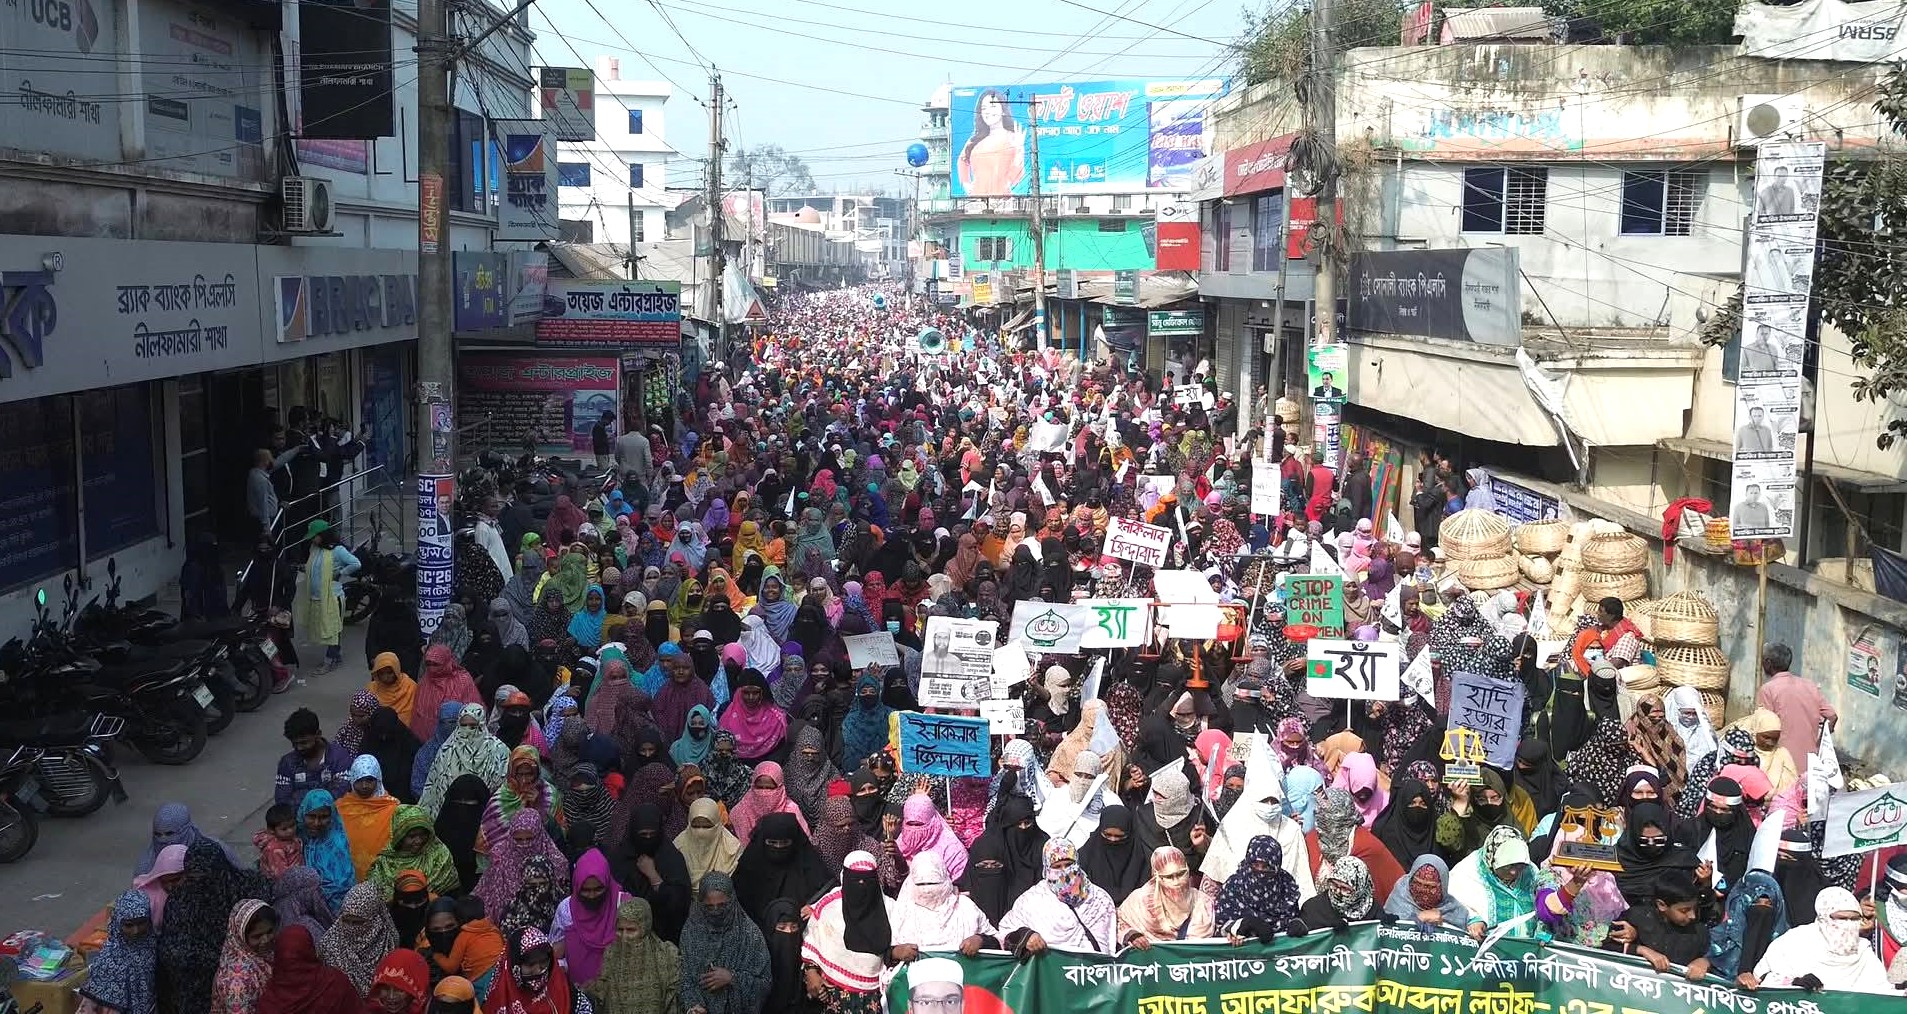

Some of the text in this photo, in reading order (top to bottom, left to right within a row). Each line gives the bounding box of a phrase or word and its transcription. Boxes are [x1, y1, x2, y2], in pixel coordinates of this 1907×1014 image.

[31, 0, 72, 31] UCB
[1840, 25, 1898, 40] BSRM
[18, 79, 101, 124] নীলফামারী শাখা
[116, 273, 236, 314] ব্র্যাক ব্যাংক পিএলসি
[1373, 271, 1446, 298] সোনালী ব্যাংক পিএলসি
[134, 318, 228, 359] নীলফামারী শাখা
[1291, 580, 1334, 596] STOP
[1289, 598, 1333, 611] CRIME
[1302, 611, 1323, 623] ON
[1324, 639, 1388, 692] হ্যাঁ
[1459, 682, 1515, 713] হাদি
[1062, 961, 1161, 985] বাংলাদেশ
[1167, 959, 1266, 984] জামায়াতে
[1523, 952, 1603, 989] নির্বাচনী
[1609, 967, 1666, 999] ঐক্য
[1672, 983, 1760, 1014] সমর্থিত
